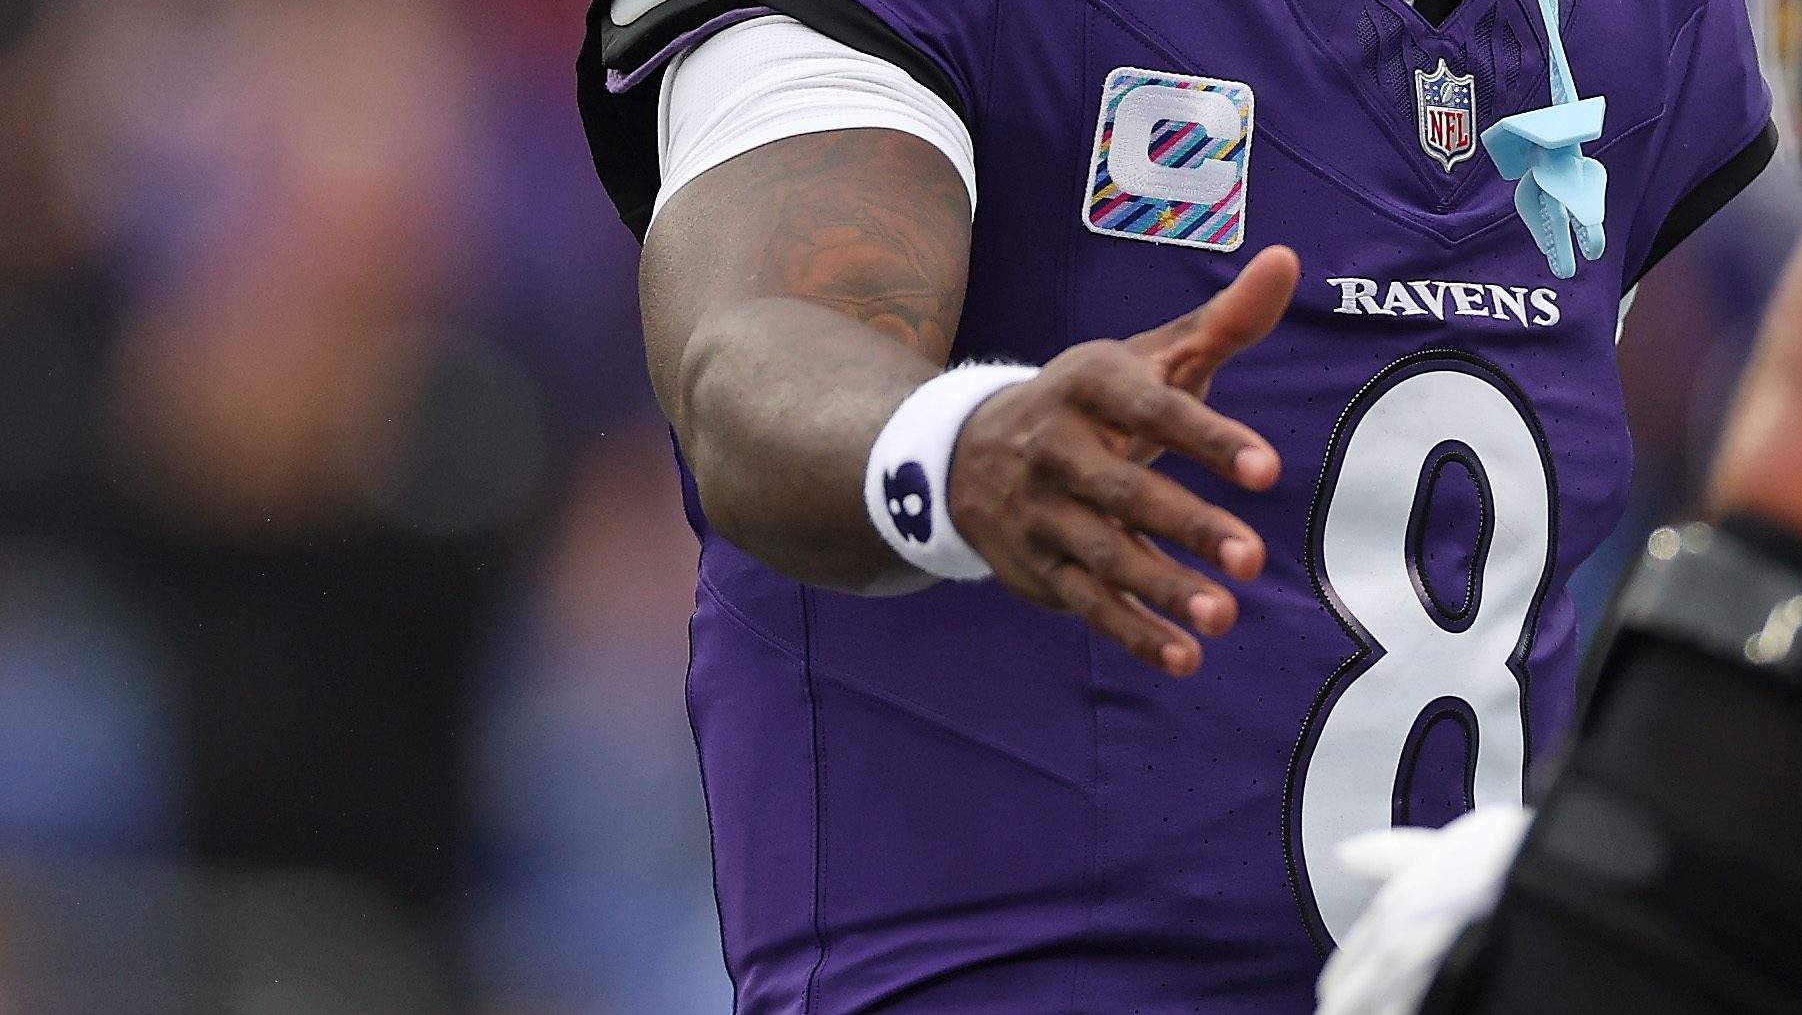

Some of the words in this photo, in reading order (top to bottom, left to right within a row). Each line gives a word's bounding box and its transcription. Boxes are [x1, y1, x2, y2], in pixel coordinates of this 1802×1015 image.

[1107, 85, 1241, 205] C
[1428, 109, 1468, 151] NFL
[1326, 277, 1561, 328] RAVENS
[1284, 349, 1557, 955] 8
